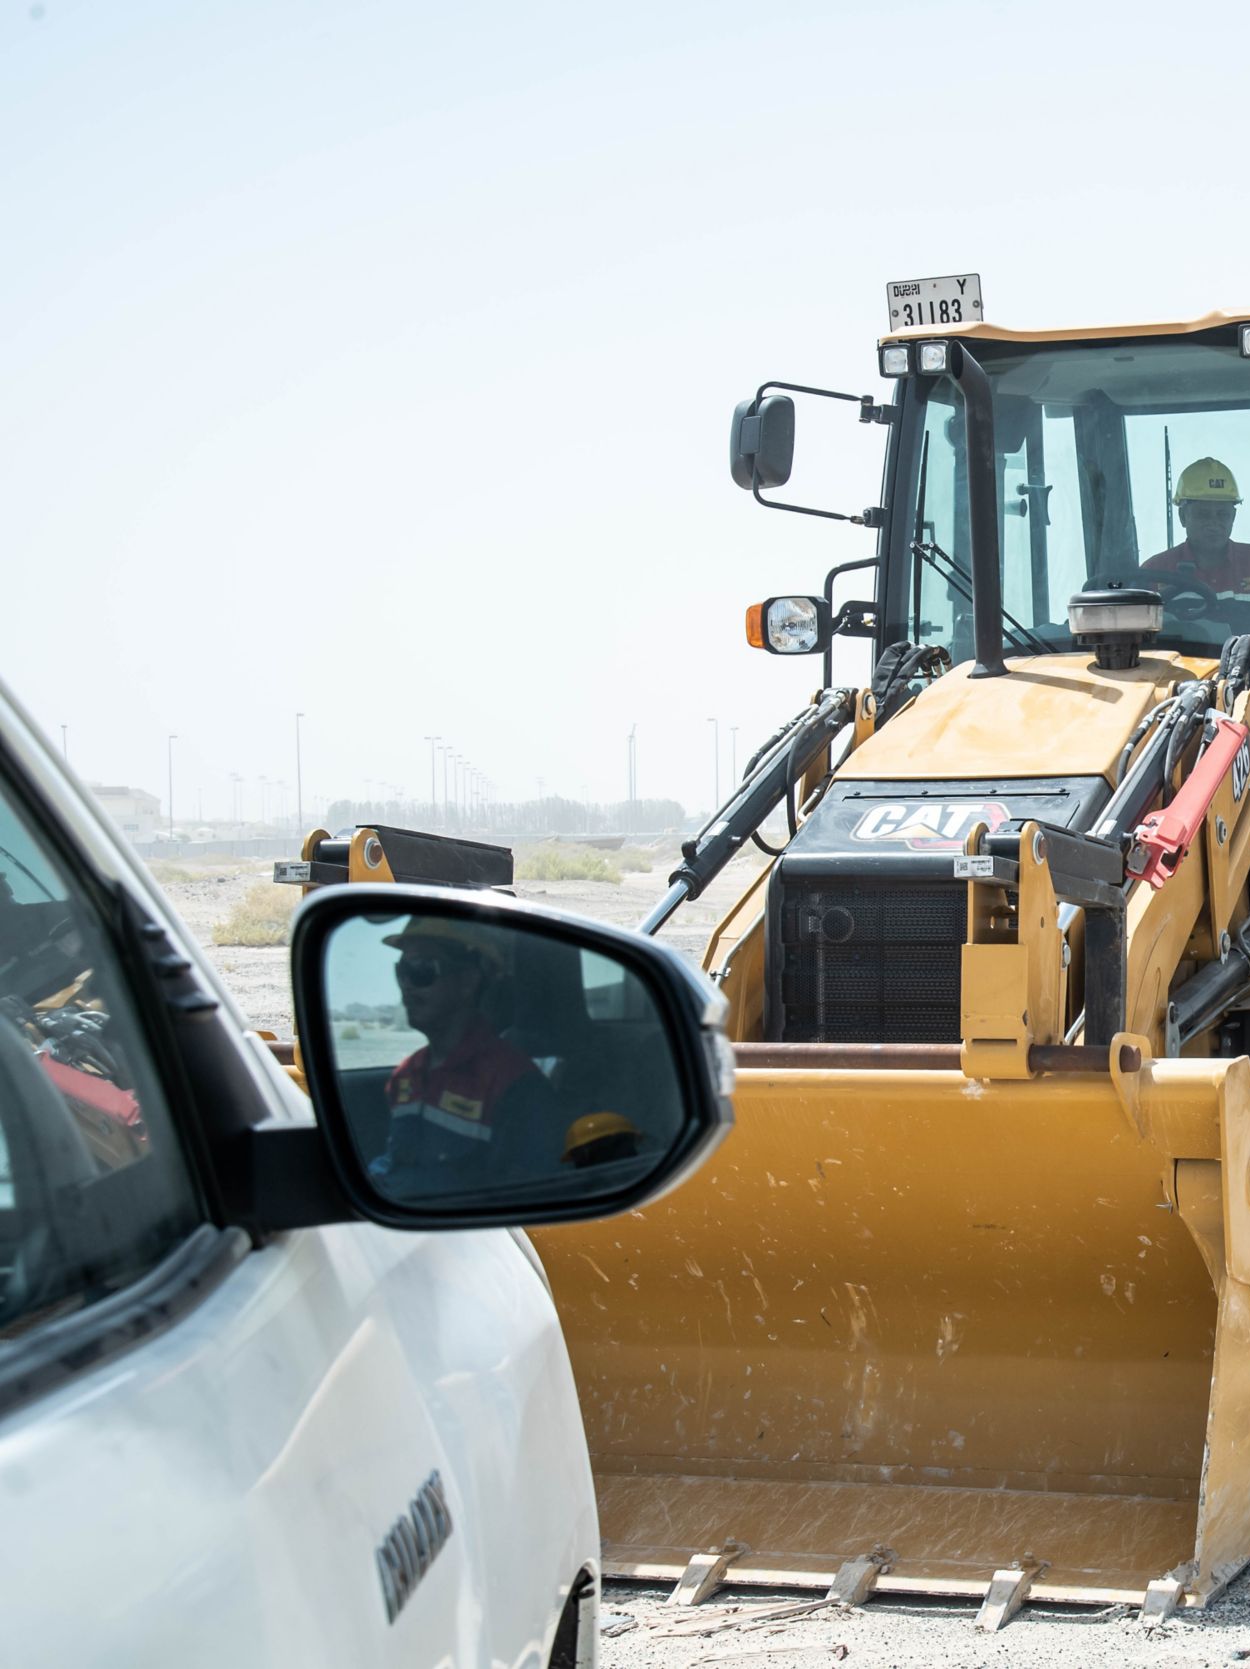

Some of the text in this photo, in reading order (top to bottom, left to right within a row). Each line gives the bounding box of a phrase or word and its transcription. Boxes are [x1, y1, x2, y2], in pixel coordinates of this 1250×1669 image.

[956, 278, 967, 296] Y
[903, 298, 963, 327] 31183
[1209, 478, 1225, 489] CAT
[855, 804, 986, 840] CAT
